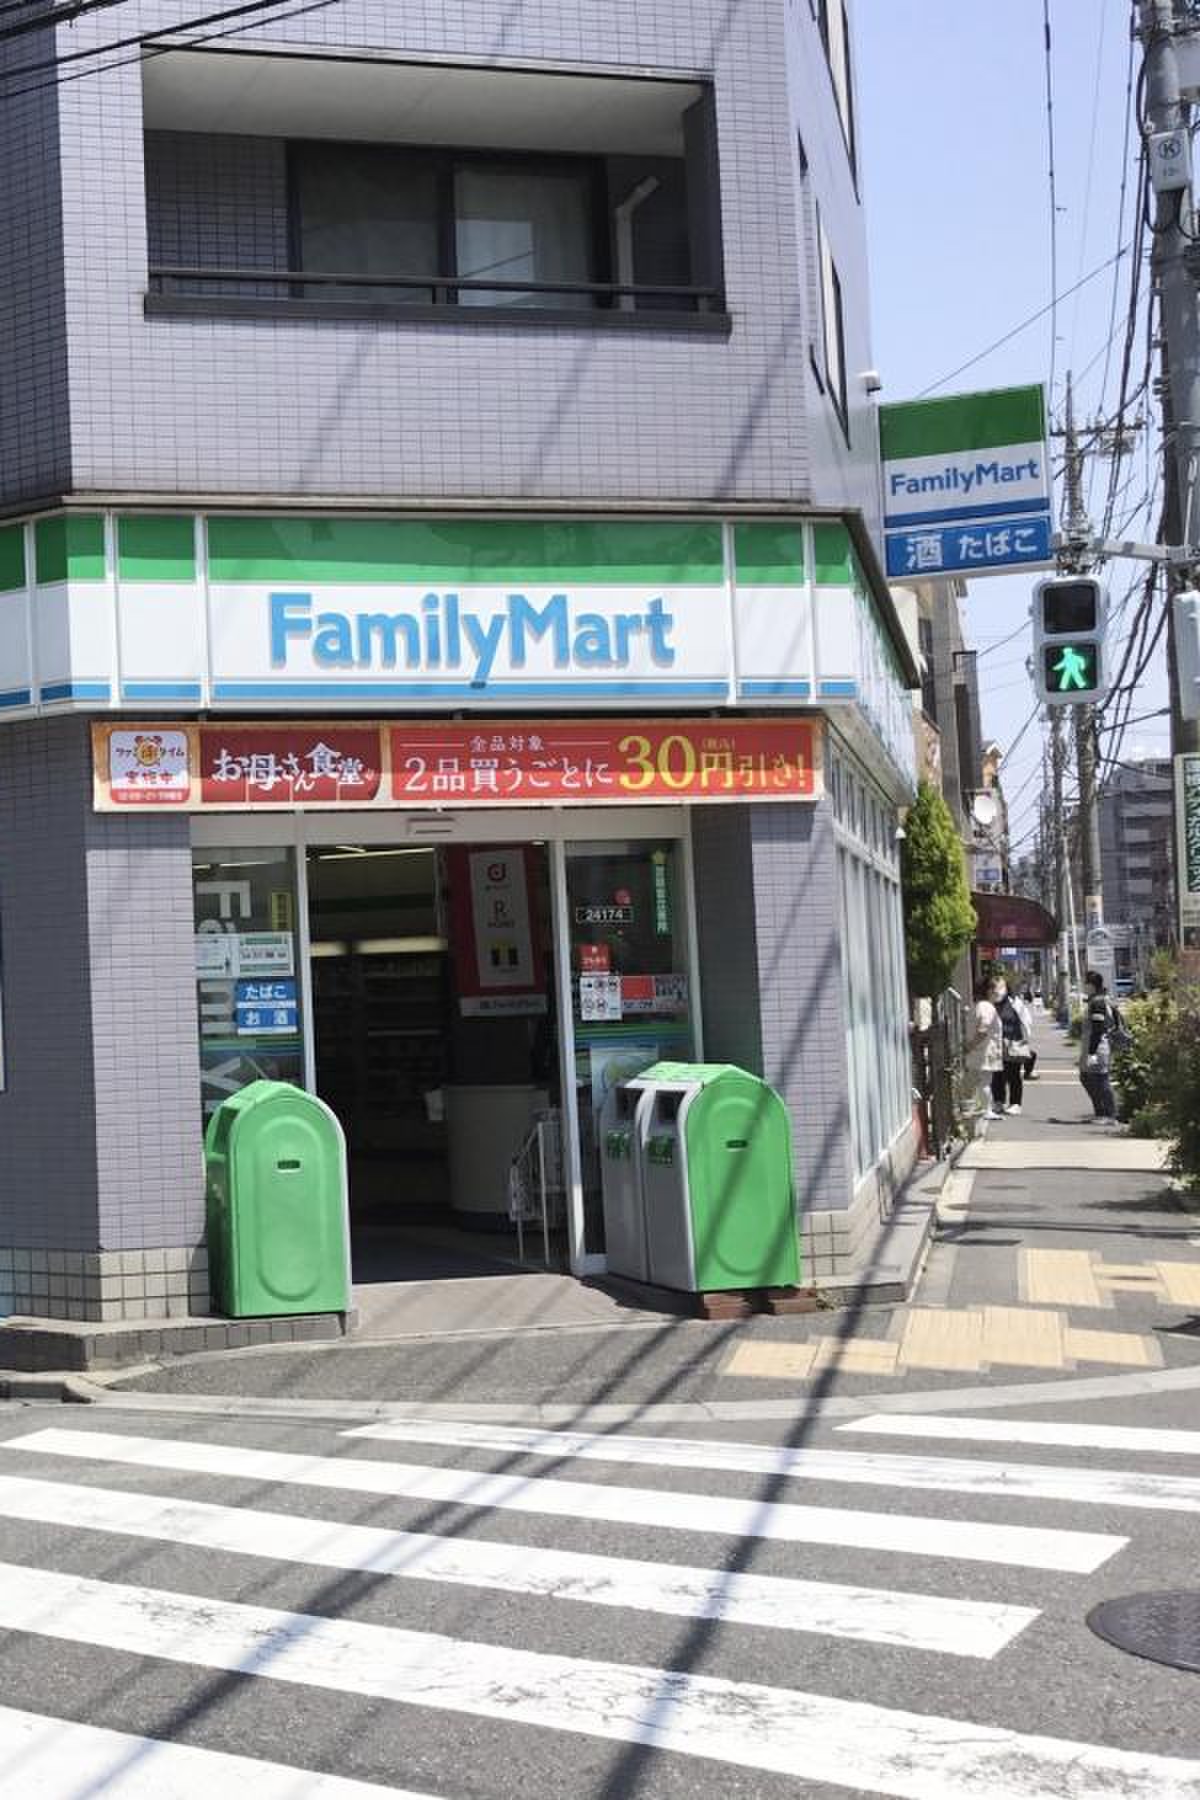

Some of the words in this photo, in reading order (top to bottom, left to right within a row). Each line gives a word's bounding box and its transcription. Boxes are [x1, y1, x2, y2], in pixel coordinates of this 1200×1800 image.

[890, 457, 1040, 496] FamilyMart
[905, 533, 943, 569] 酒
[958, 527, 1038, 560] たばこ
[268, 592, 676, 687] FamilyMart
[210, 742, 365, 791] お母さん食堂
[245, 984, 288, 1000] たばこ
